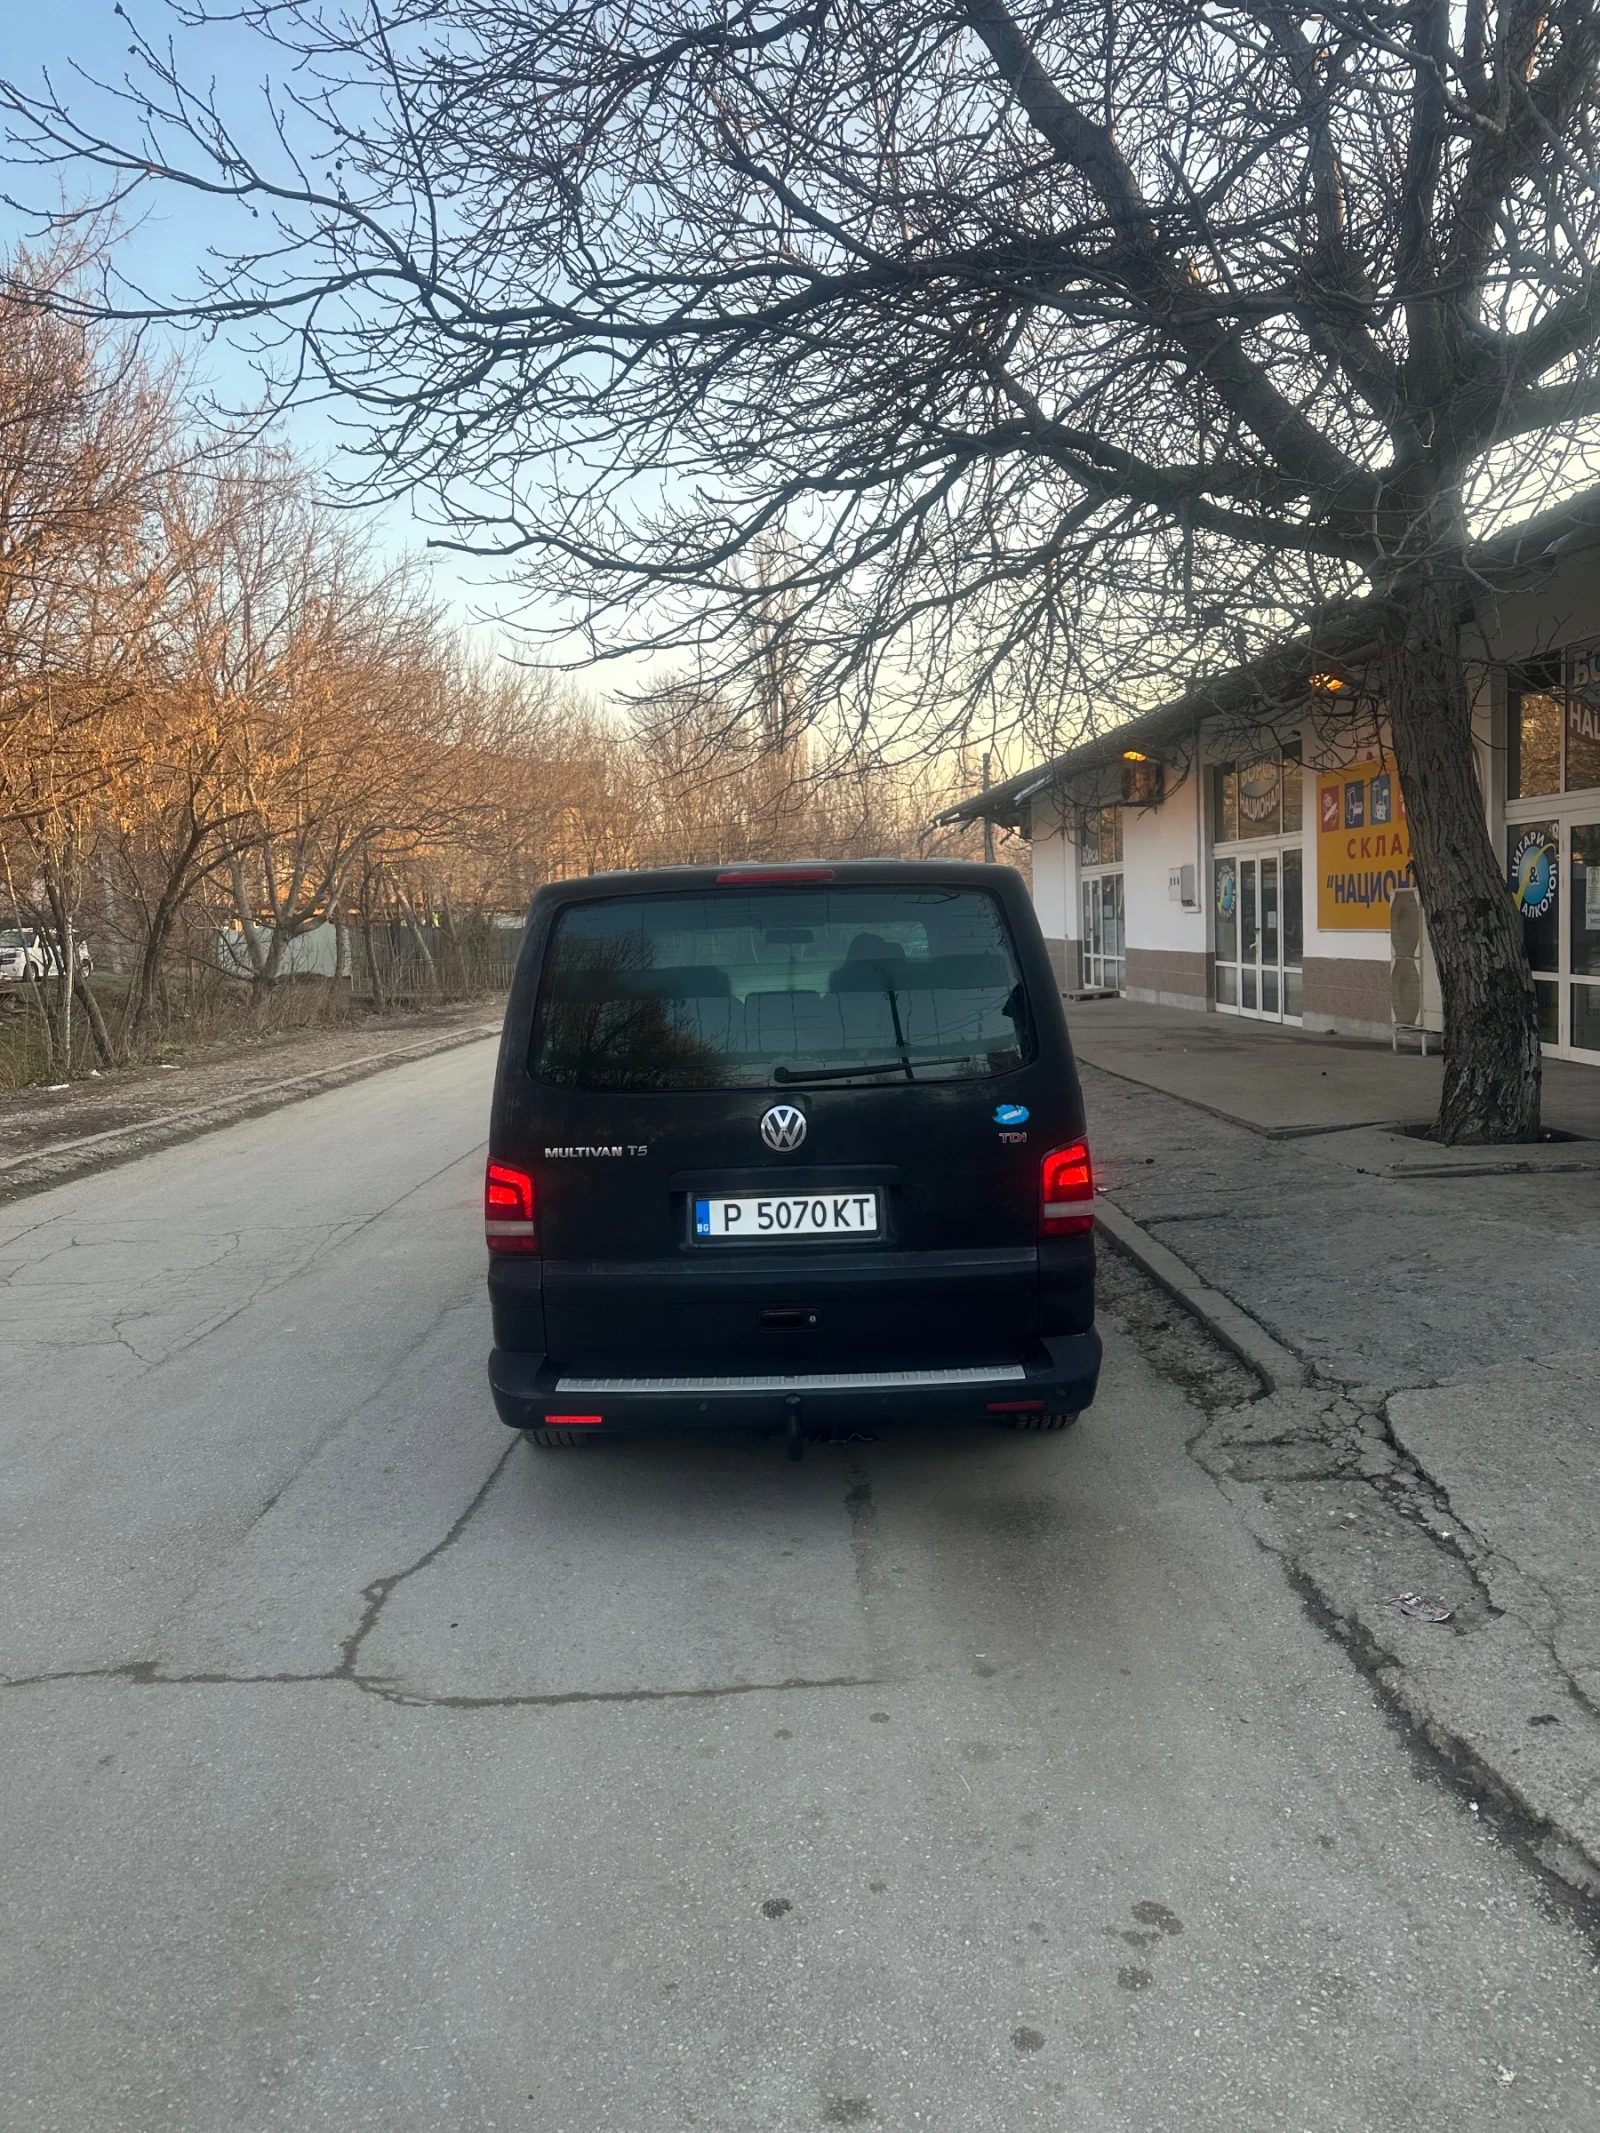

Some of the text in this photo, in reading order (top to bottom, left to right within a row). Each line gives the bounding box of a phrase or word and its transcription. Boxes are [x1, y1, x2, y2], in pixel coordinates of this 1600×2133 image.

[1240, 782, 1280, 821] НАЦИОНАЛ
[1511, 831, 1545, 877] ЦИГАРИ
[1521, 863, 1557, 918] АЛКОХОЛ
[999, 1132, 1027, 1143] TDI
[544, 1145, 648, 1158] MULTIVAN T5
[697, 1223, 709, 1232] BG
